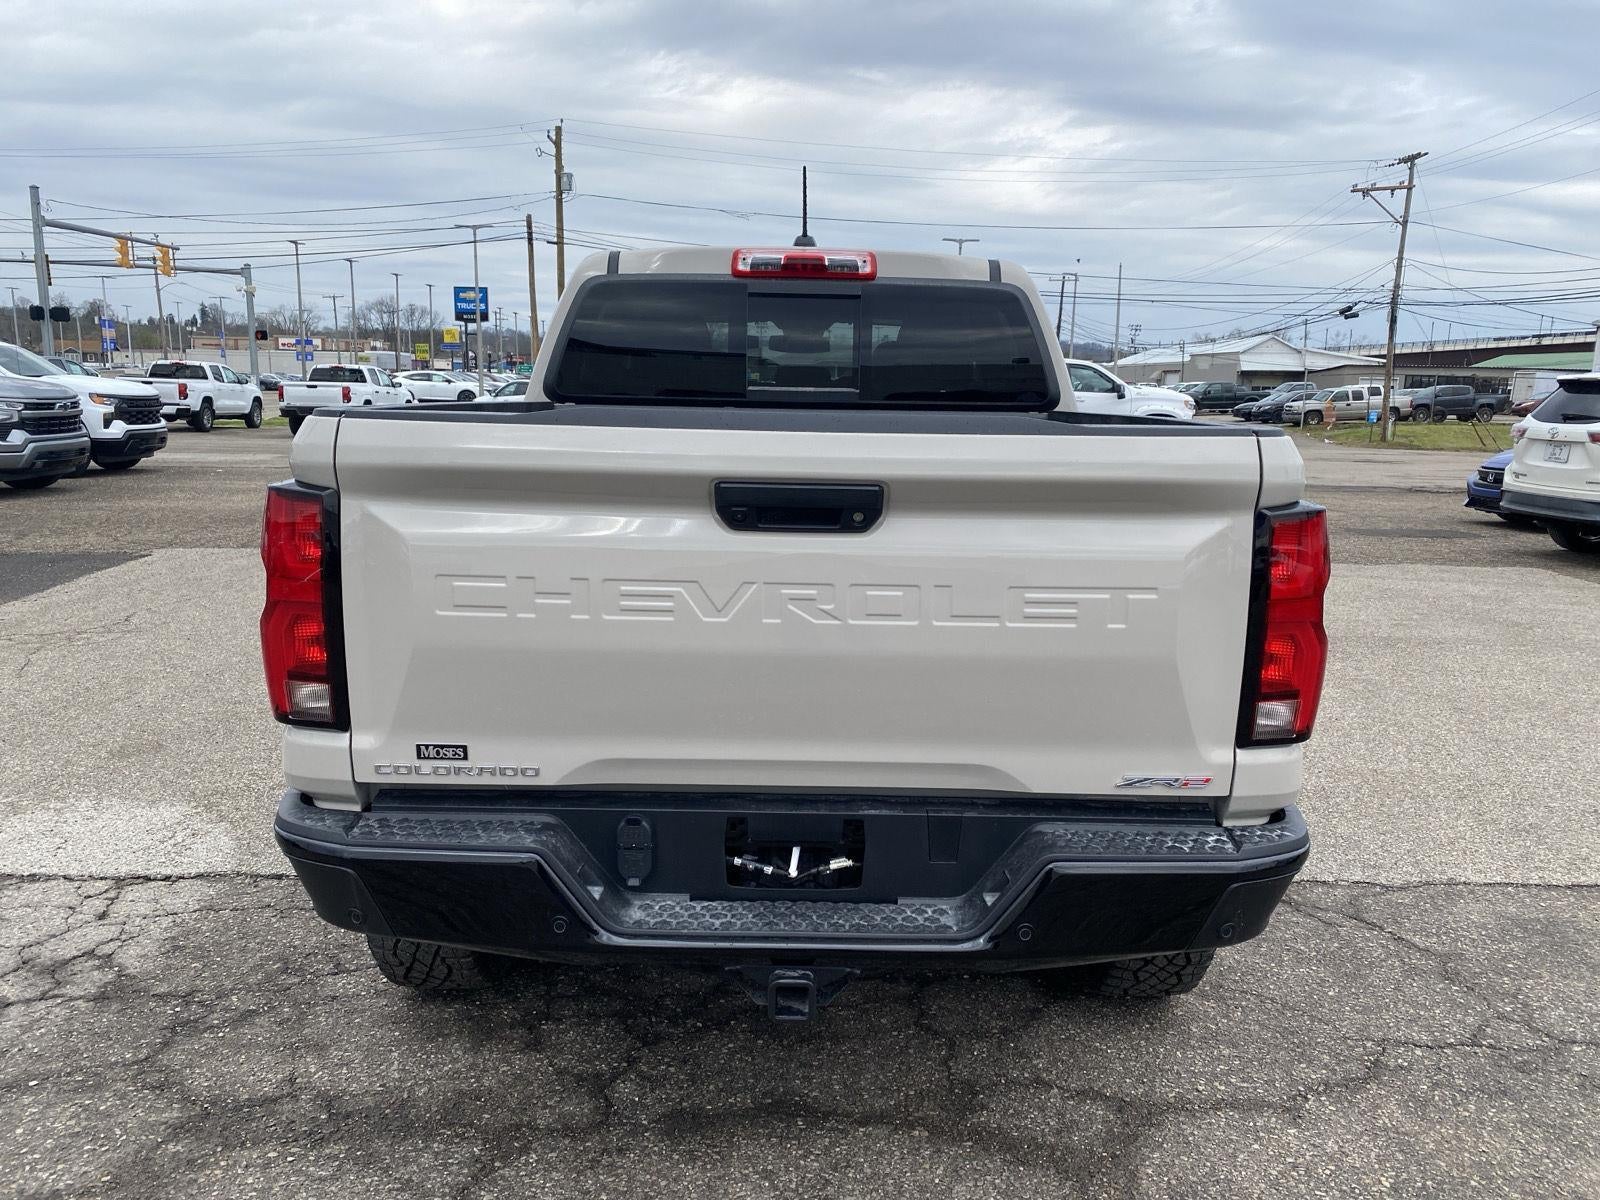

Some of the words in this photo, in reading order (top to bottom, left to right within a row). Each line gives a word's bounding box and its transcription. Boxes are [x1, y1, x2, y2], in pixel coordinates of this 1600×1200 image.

[456, 302, 486, 310] TRUCS
[435, 573, 1159, 629] CHEVROLET
[419, 745, 465, 759] MOSES
[374, 763, 540, 777] COLORADO
[1114, 775, 1214, 789] ZR2
